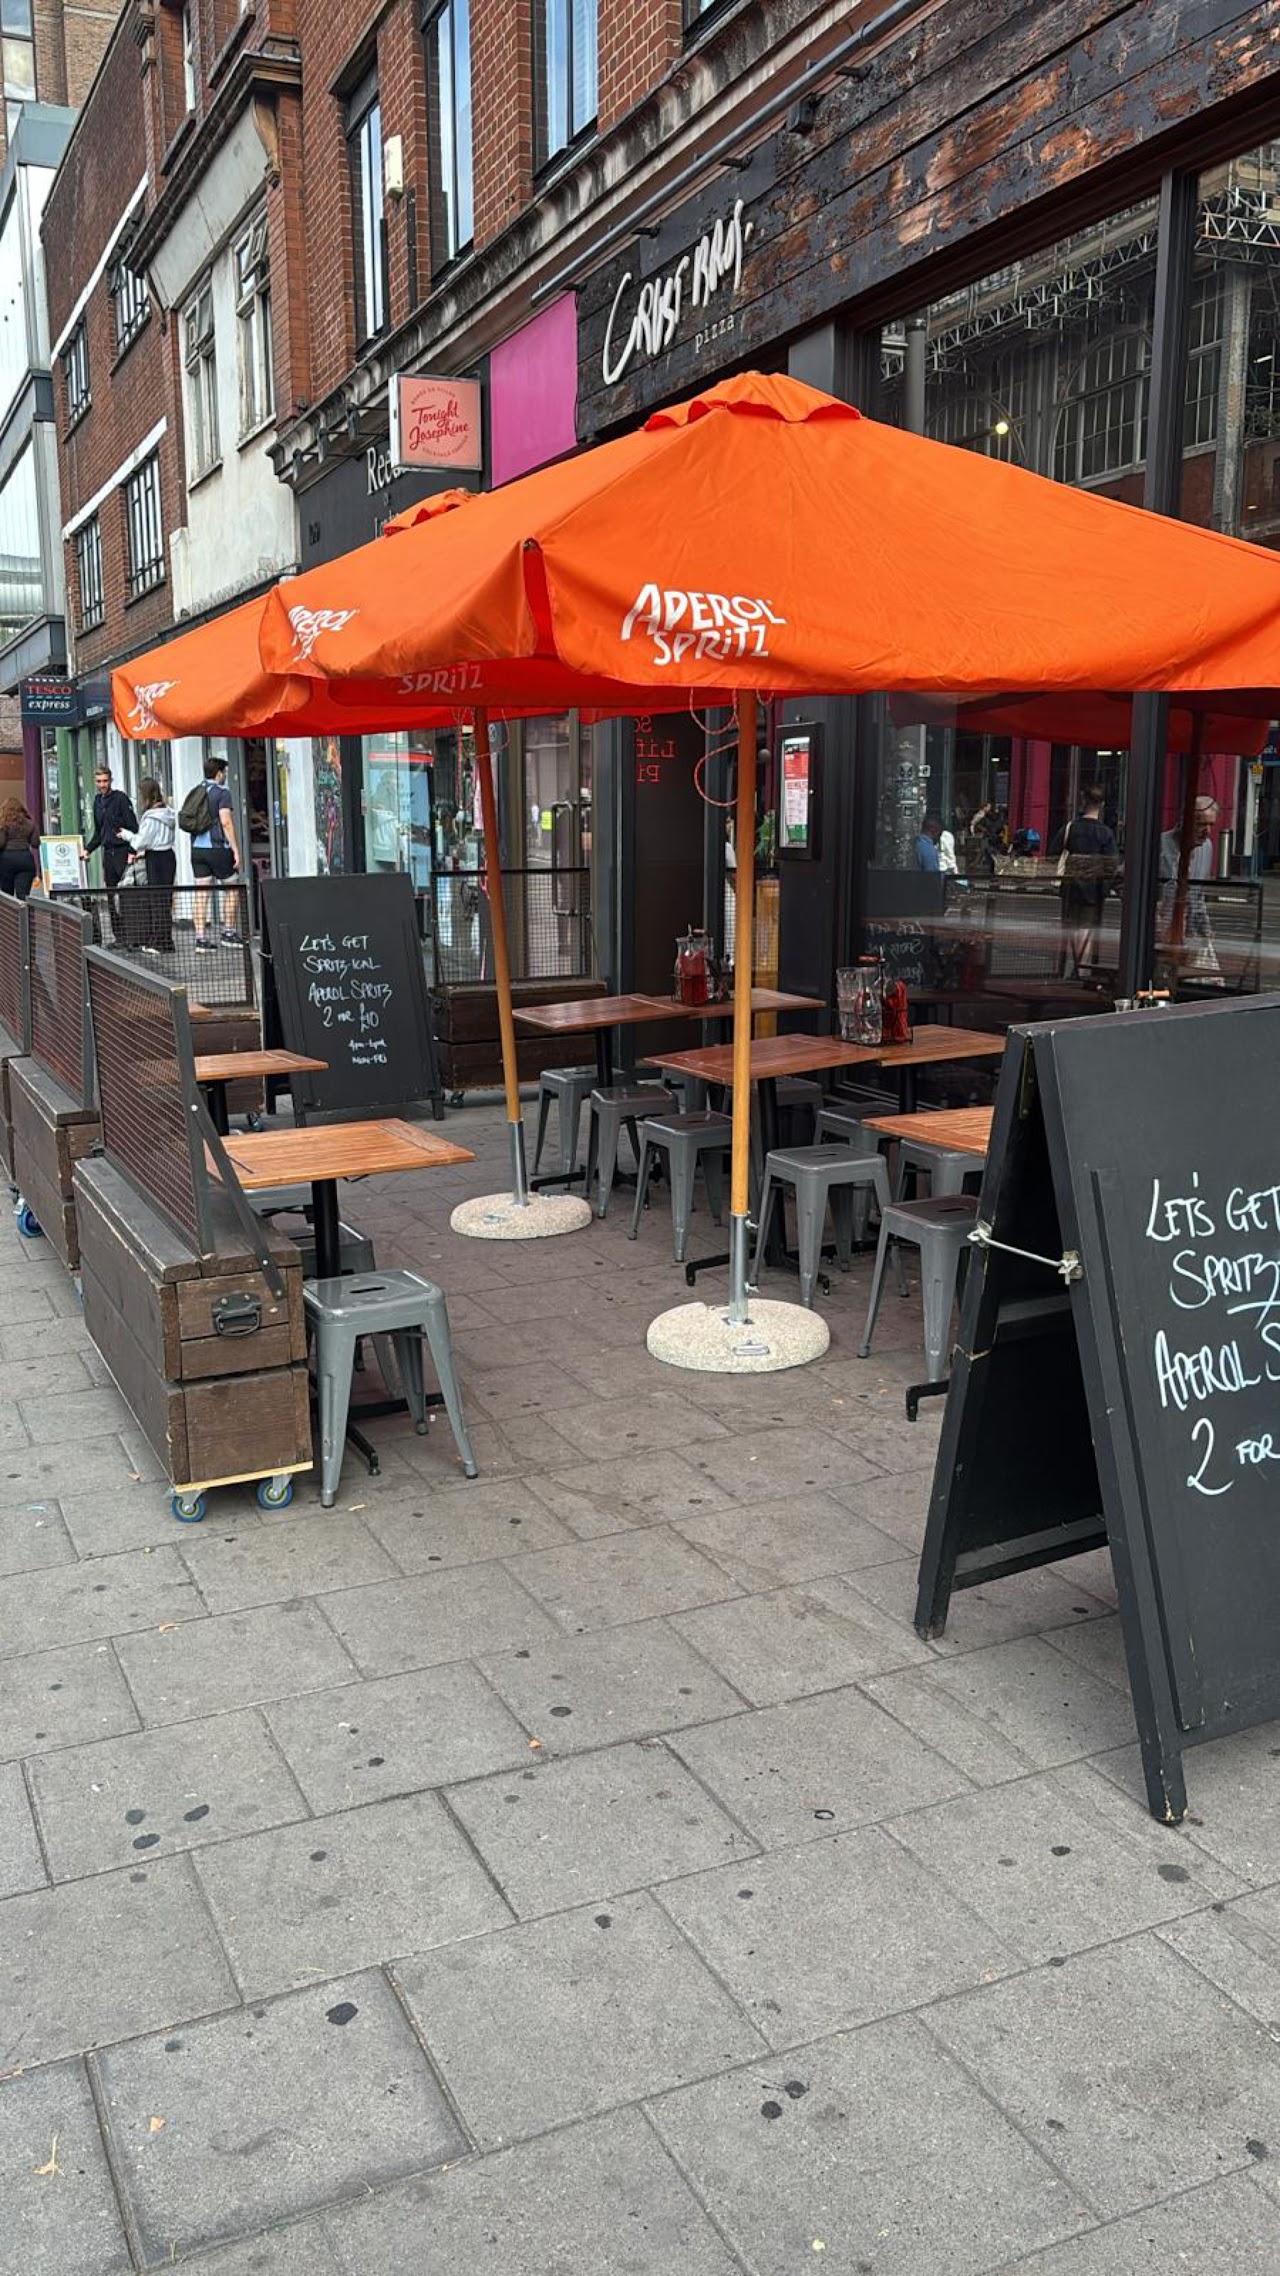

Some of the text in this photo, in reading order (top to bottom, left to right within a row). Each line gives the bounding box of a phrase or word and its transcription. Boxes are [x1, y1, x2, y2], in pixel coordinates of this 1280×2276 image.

[694, 313, 735, 353] pizza
[411, 399, 459, 428] Tonight
[409, 421, 470, 451] Josephine
[621, 583, 788, 641] APEROL
[27, 685, 72, 695] TESCO
[28, 699, 71, 711] express
[300, 933, 369, 951] LET'S GET
[308, 979, 393, 1009] APEROL SPRITZ
[322, 1005, 333, 1028] 2
[359, 1002, 380, 1033] £10
[1145, 1171, 1216, 1242] LET'S
[1154, 1329, 1262, 1412] APEROL
[1186, 1417, 1280, 1496] 2 FOR
